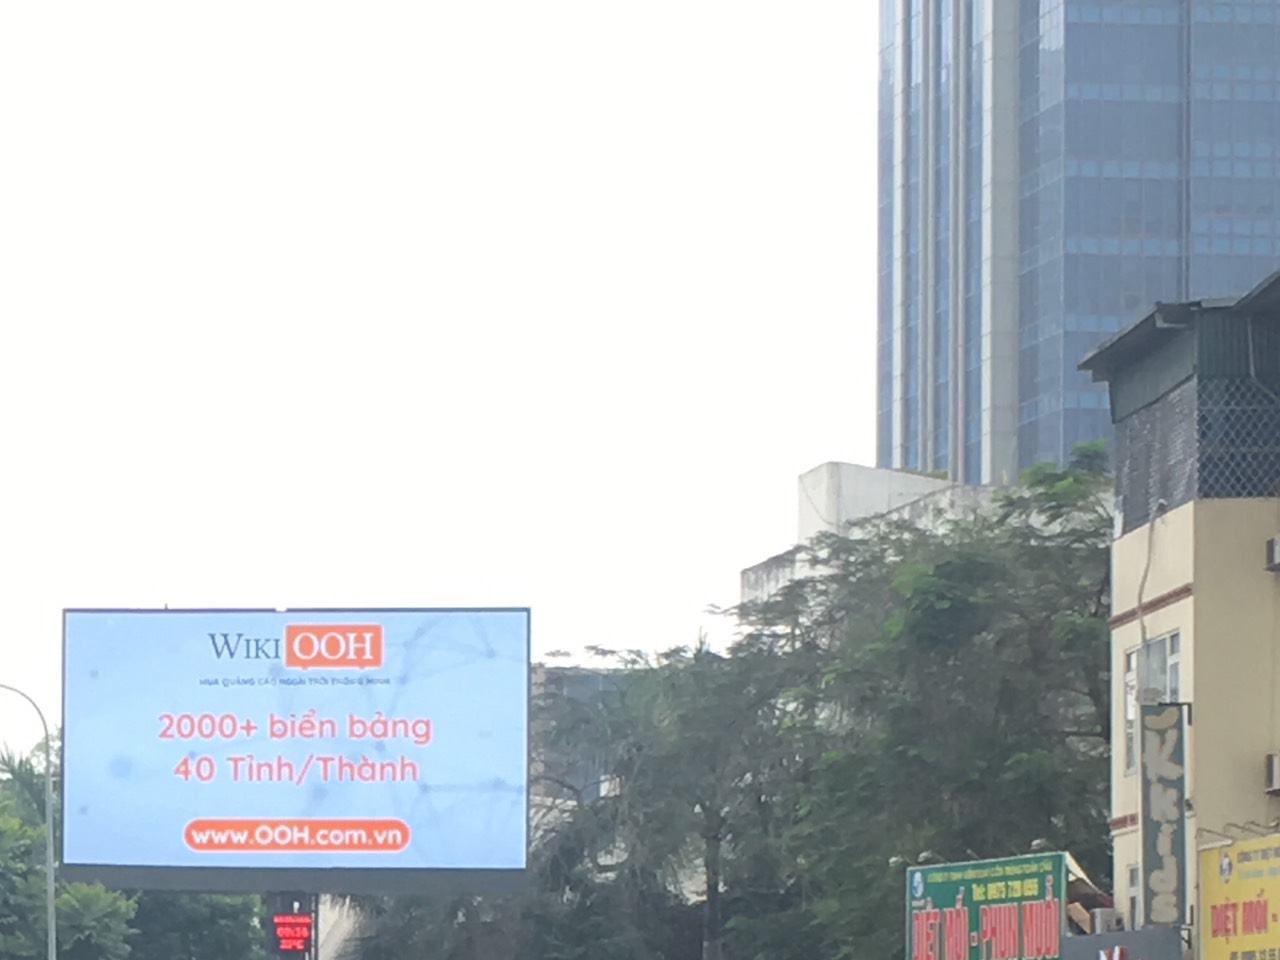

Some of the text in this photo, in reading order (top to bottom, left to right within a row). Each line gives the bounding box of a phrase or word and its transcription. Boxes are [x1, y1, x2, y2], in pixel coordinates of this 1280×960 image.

[292, 632, 374, 660] OOH
[158, 709, 433, 745] 2000+ biển bảng
[173, 753, 419, 786] 40 Tỉnh/Thành
[191, 824, 403, 846] www.OOH.com.vn
